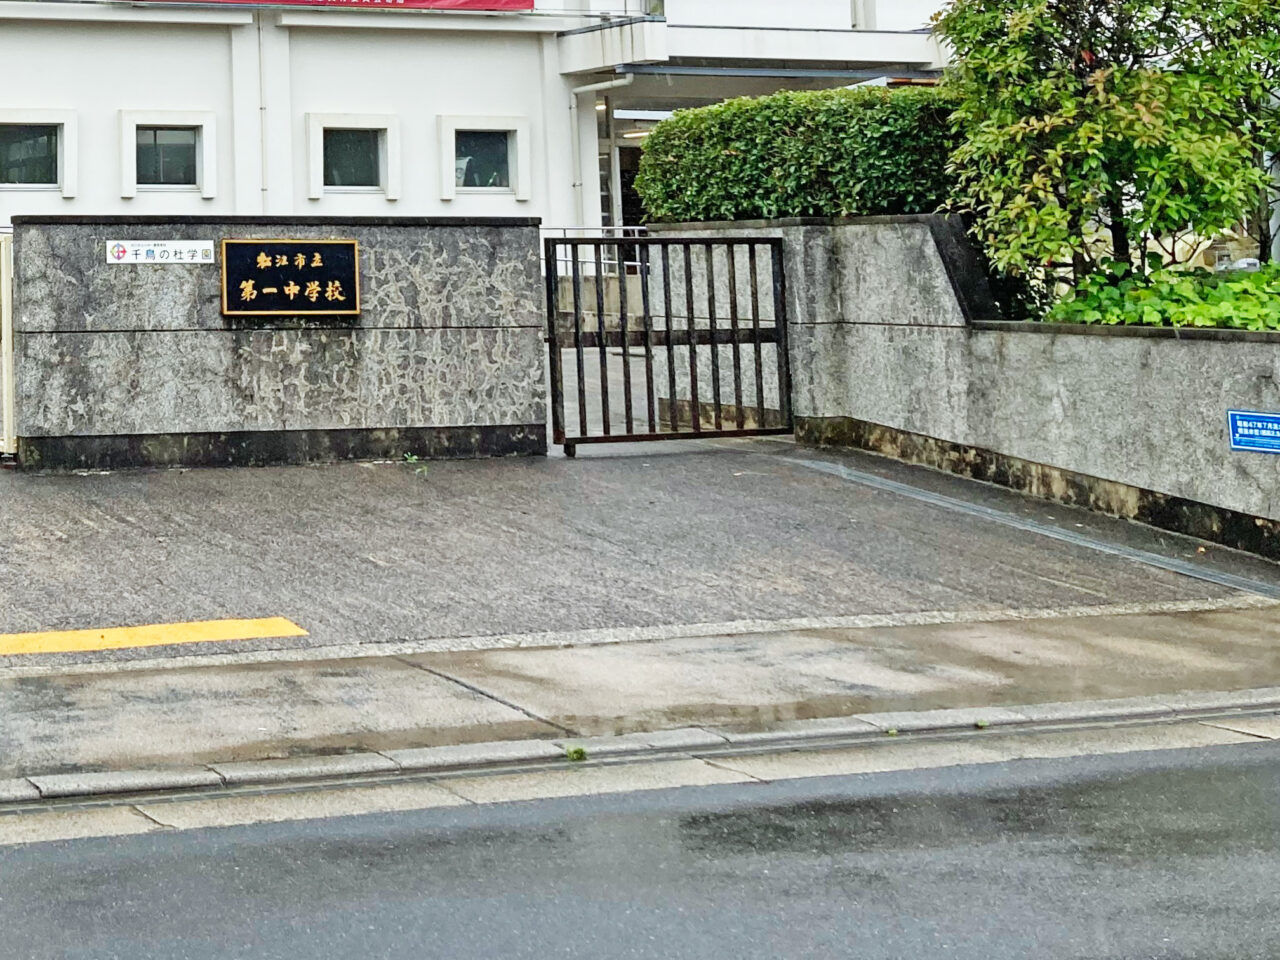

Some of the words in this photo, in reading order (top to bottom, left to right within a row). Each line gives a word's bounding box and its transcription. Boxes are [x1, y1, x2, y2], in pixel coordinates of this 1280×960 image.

[256, 251, 324, 270] 松江市立
[238, 279, 347, 302] 第一中学校
